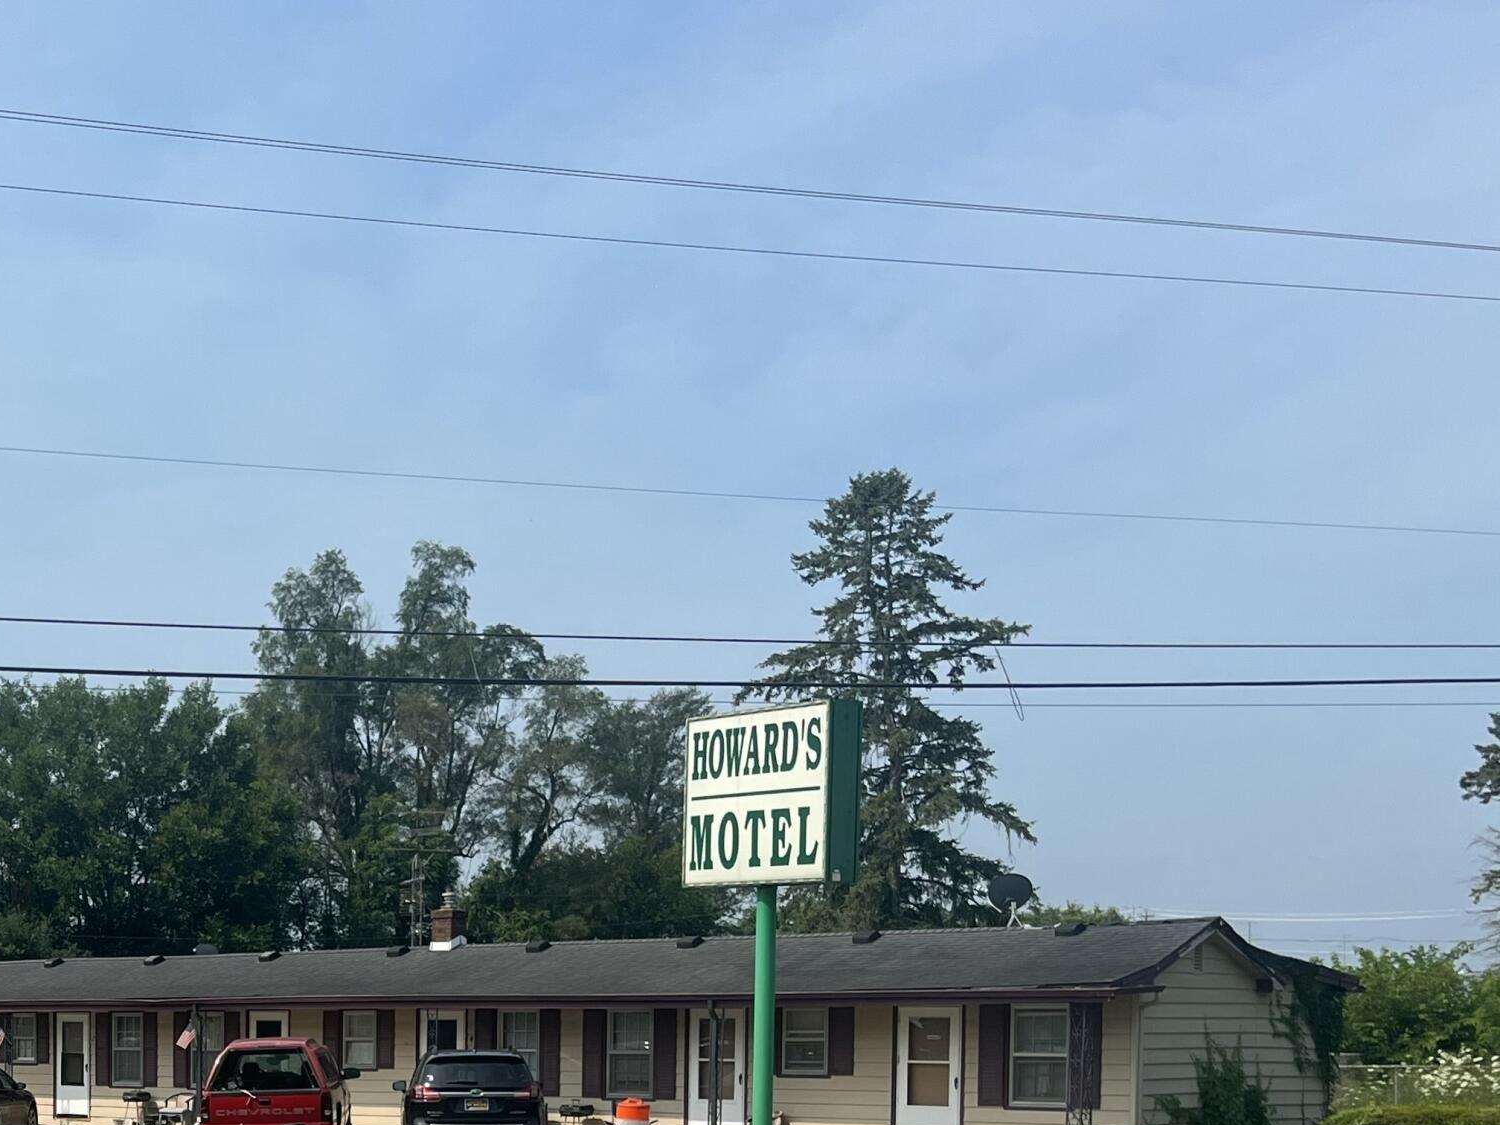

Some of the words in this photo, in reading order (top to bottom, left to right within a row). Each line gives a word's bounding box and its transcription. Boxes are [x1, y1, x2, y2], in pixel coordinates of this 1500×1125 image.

[692, 717, 822, 781] HOWARD'S
[689, 806, 819, 871] MOTEL
[215, 1107, 315, 1116] CHEVROLET
